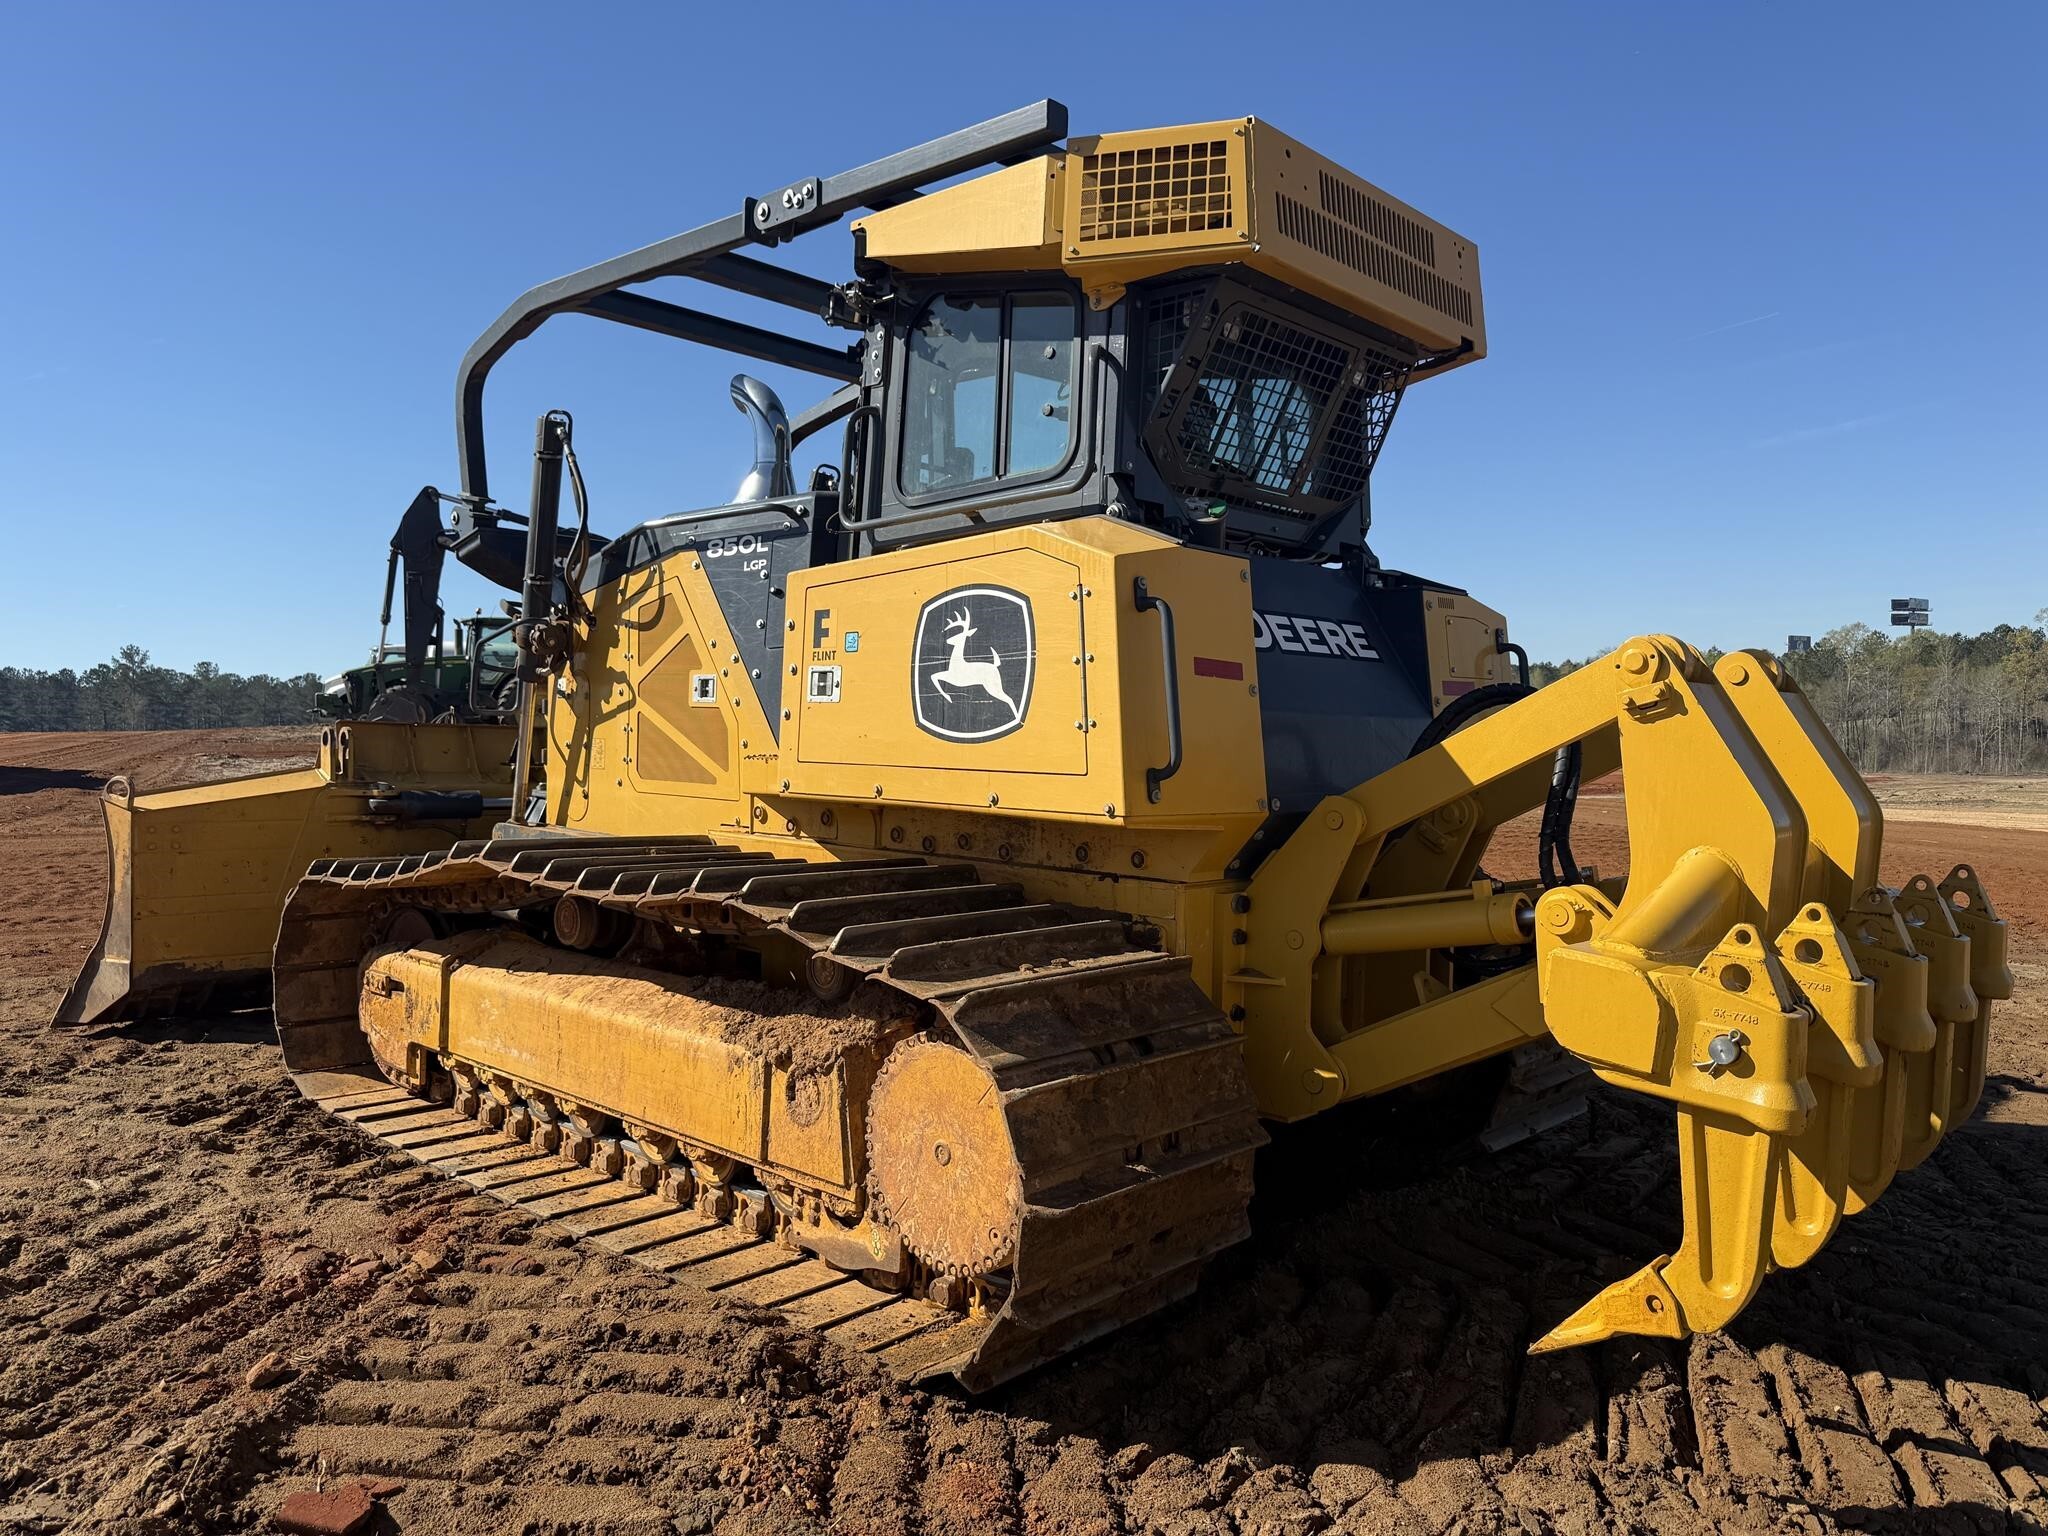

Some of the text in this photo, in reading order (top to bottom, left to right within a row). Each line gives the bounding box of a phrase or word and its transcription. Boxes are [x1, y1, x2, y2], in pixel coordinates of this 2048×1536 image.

[706, 535, 769, 559] 850L
[743, 559, 767, 572] LGP
[1252, 609, 1380, 659] DEERE
[812, 650, 837, 662] FLINT
